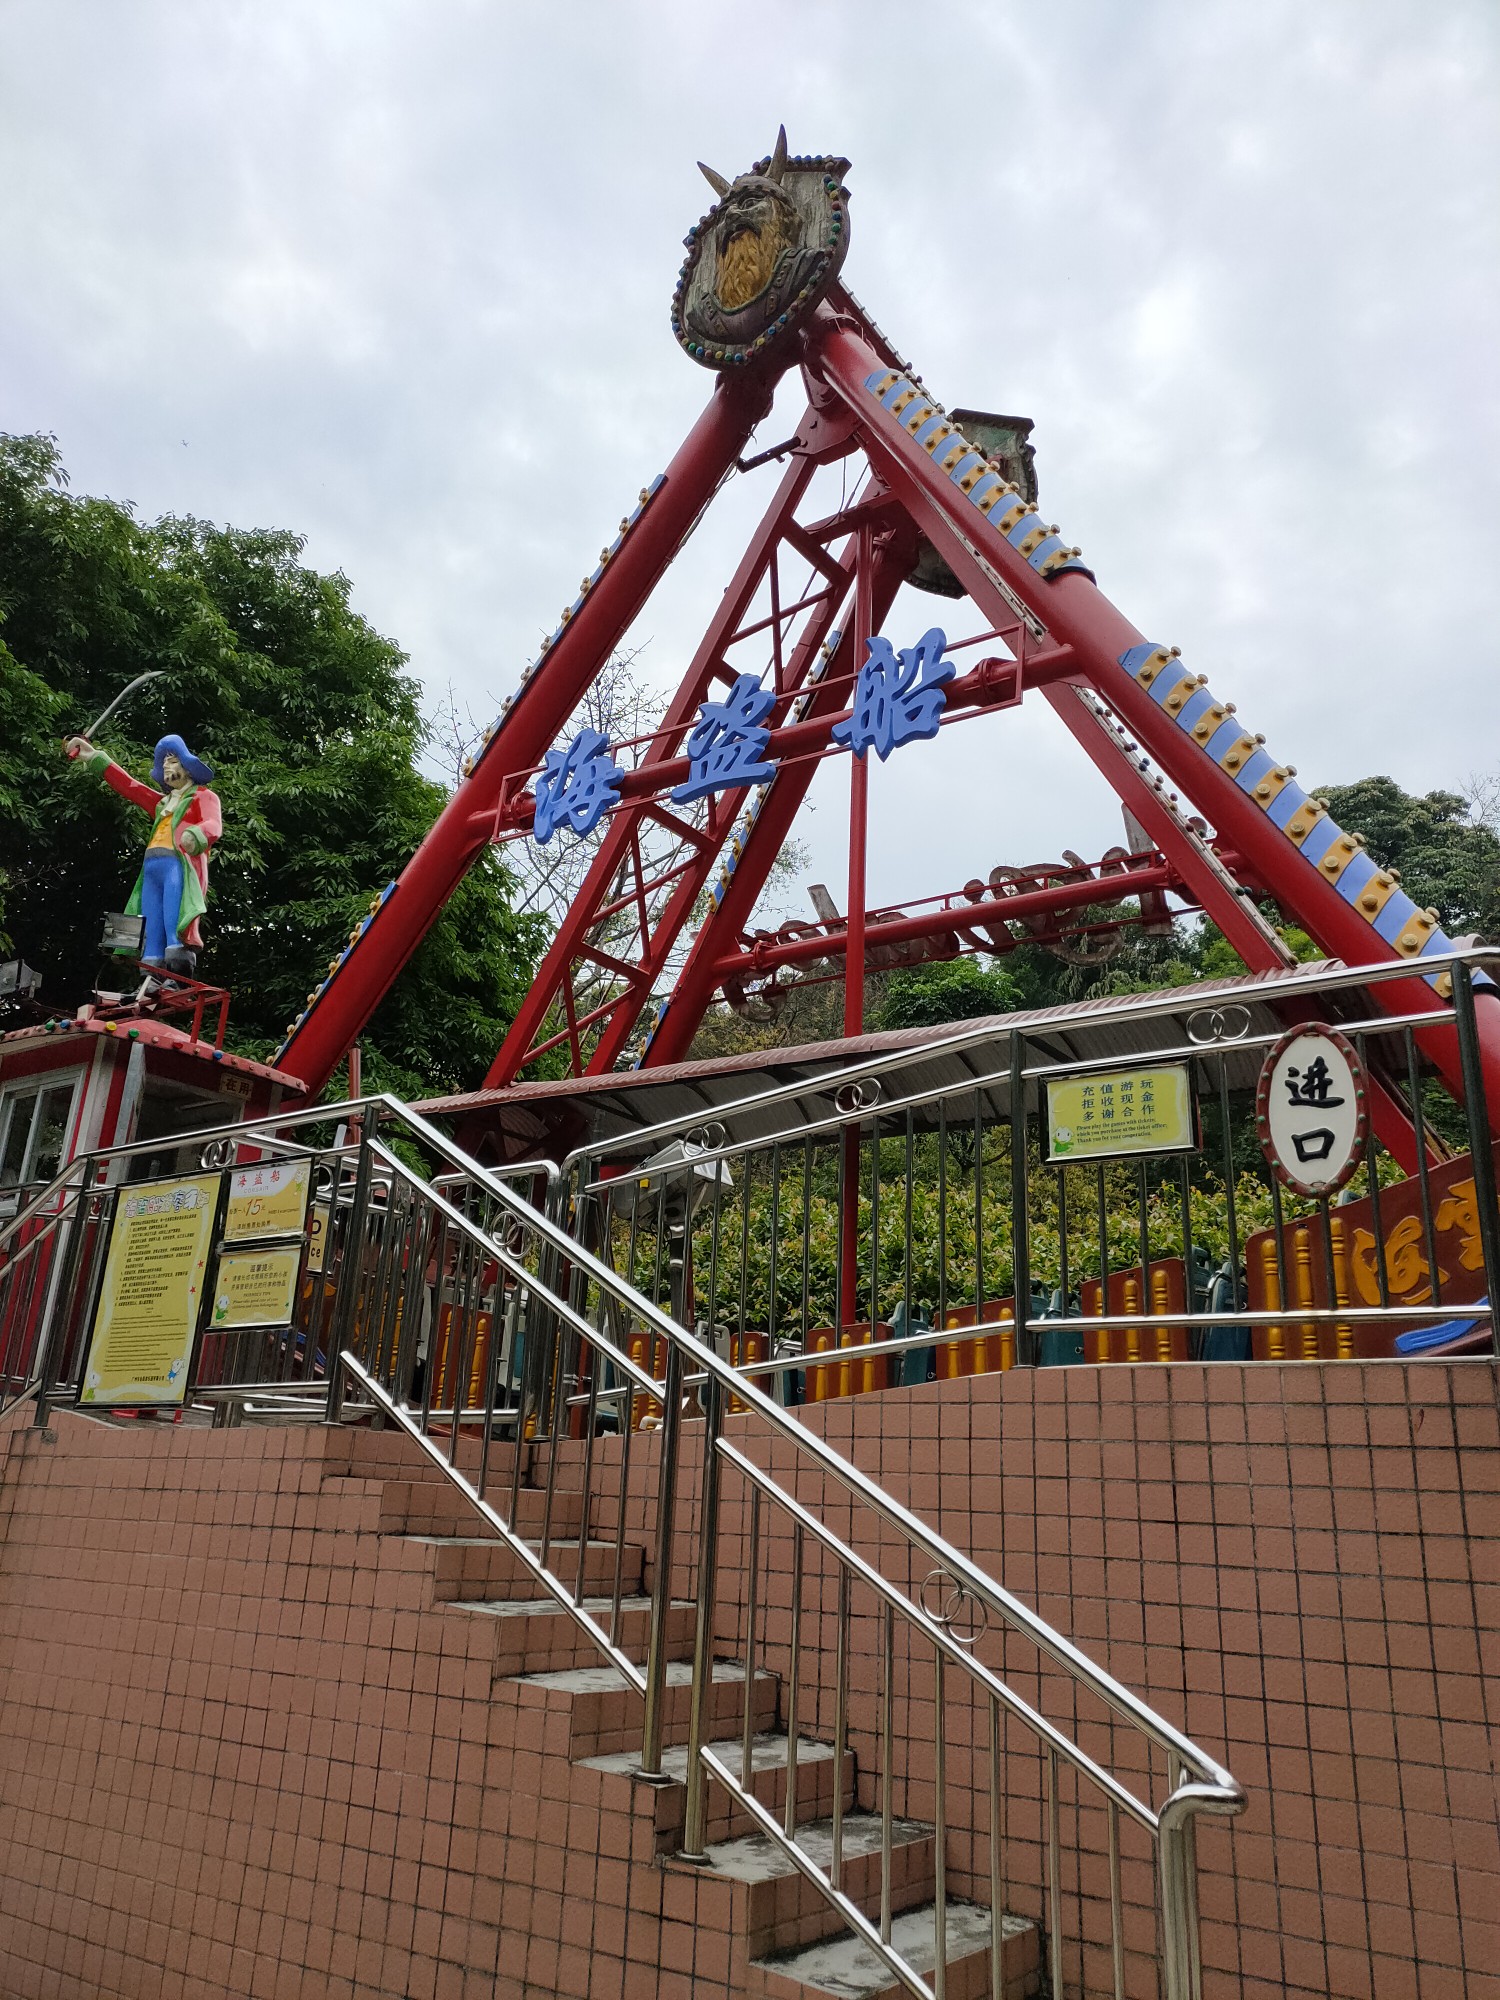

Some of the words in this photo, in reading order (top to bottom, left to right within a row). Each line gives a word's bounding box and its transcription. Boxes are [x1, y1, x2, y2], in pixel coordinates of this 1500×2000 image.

[533, 627, 957, 846] 海盗船
[1082, 1079, 1154, 1096] 充值游玩
[1082, 1091, 1155, 1110] 拒收现金
[1284, 1055, 1345, 1162] 进口
[1083, 1104, 1155, 1122] 多谢合作
[238, 1169, 280, 1187] 海盗船
[246, 1198, 263, 1216] 15
